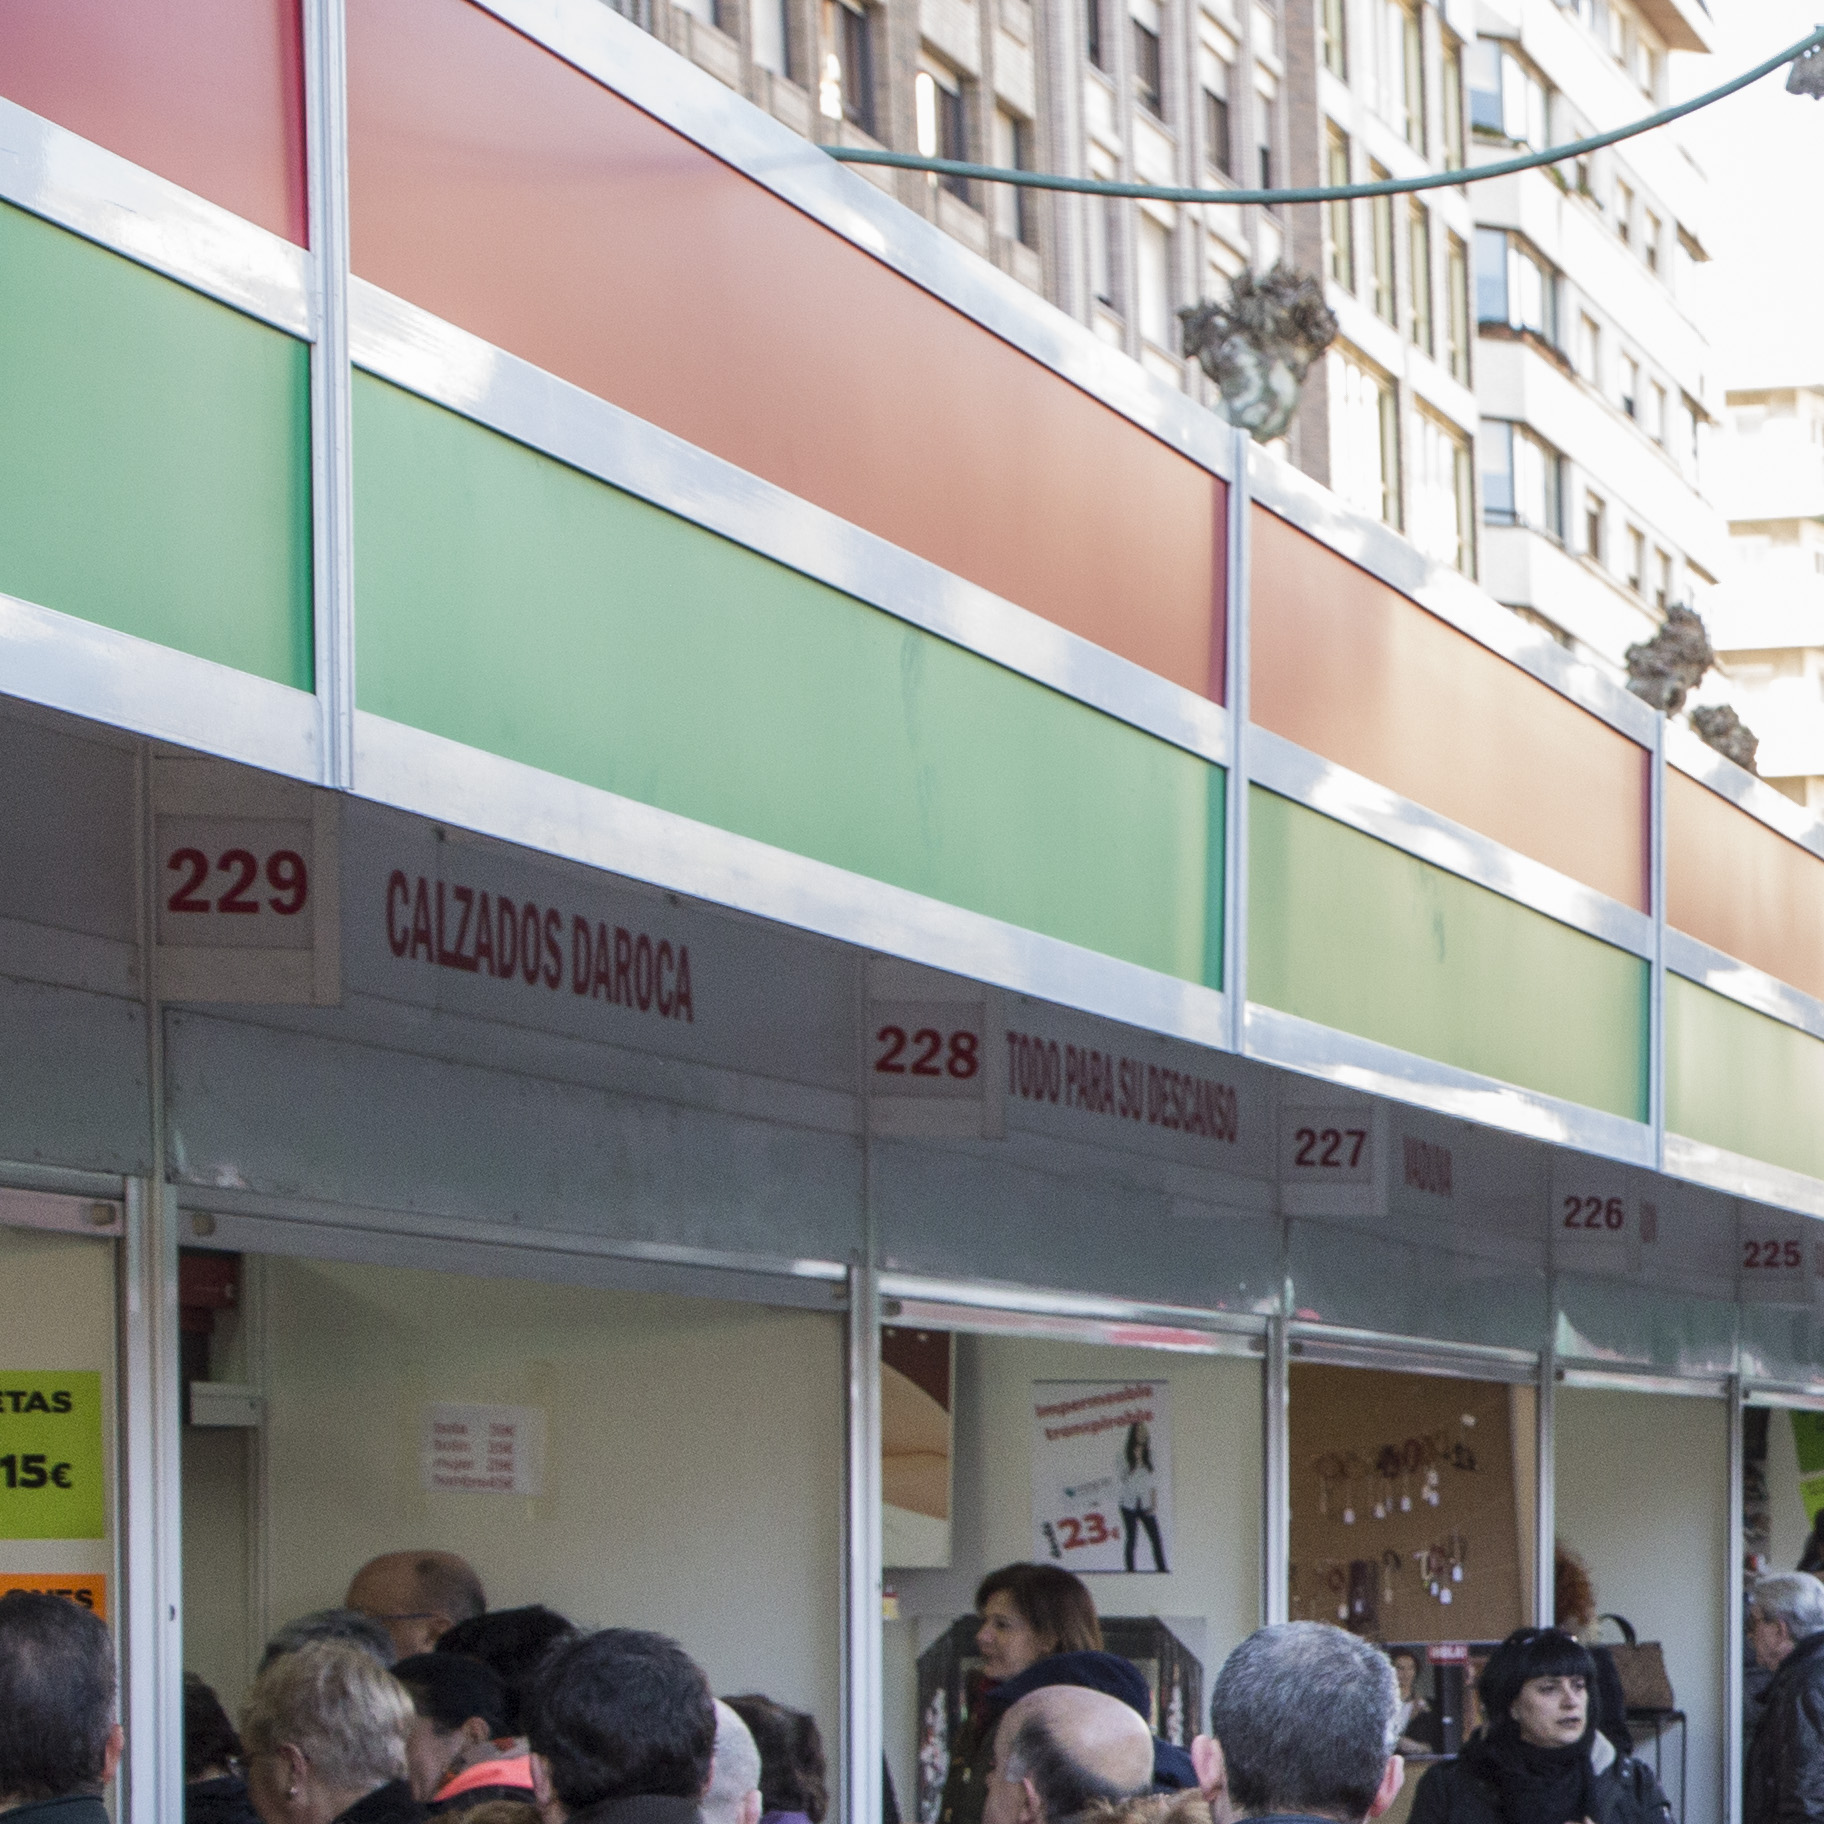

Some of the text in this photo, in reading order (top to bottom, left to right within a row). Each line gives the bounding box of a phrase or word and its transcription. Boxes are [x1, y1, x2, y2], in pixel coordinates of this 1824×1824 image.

[166, 847, 308, 915] 229
[386, 868, 694, 1023] CALZADOS DAROCA
[875, 1025, 981, 1079] 228
[1006, 1030, 1239, 1144] TODO PARA SU DESCANSO
[1294, 1127, 1368, 1168] 227
[1563, 1195, 1624, 1230] 226
[1743, 1240, 1801, 1269] 225
[0, 1389, 72, 1414] TAS
